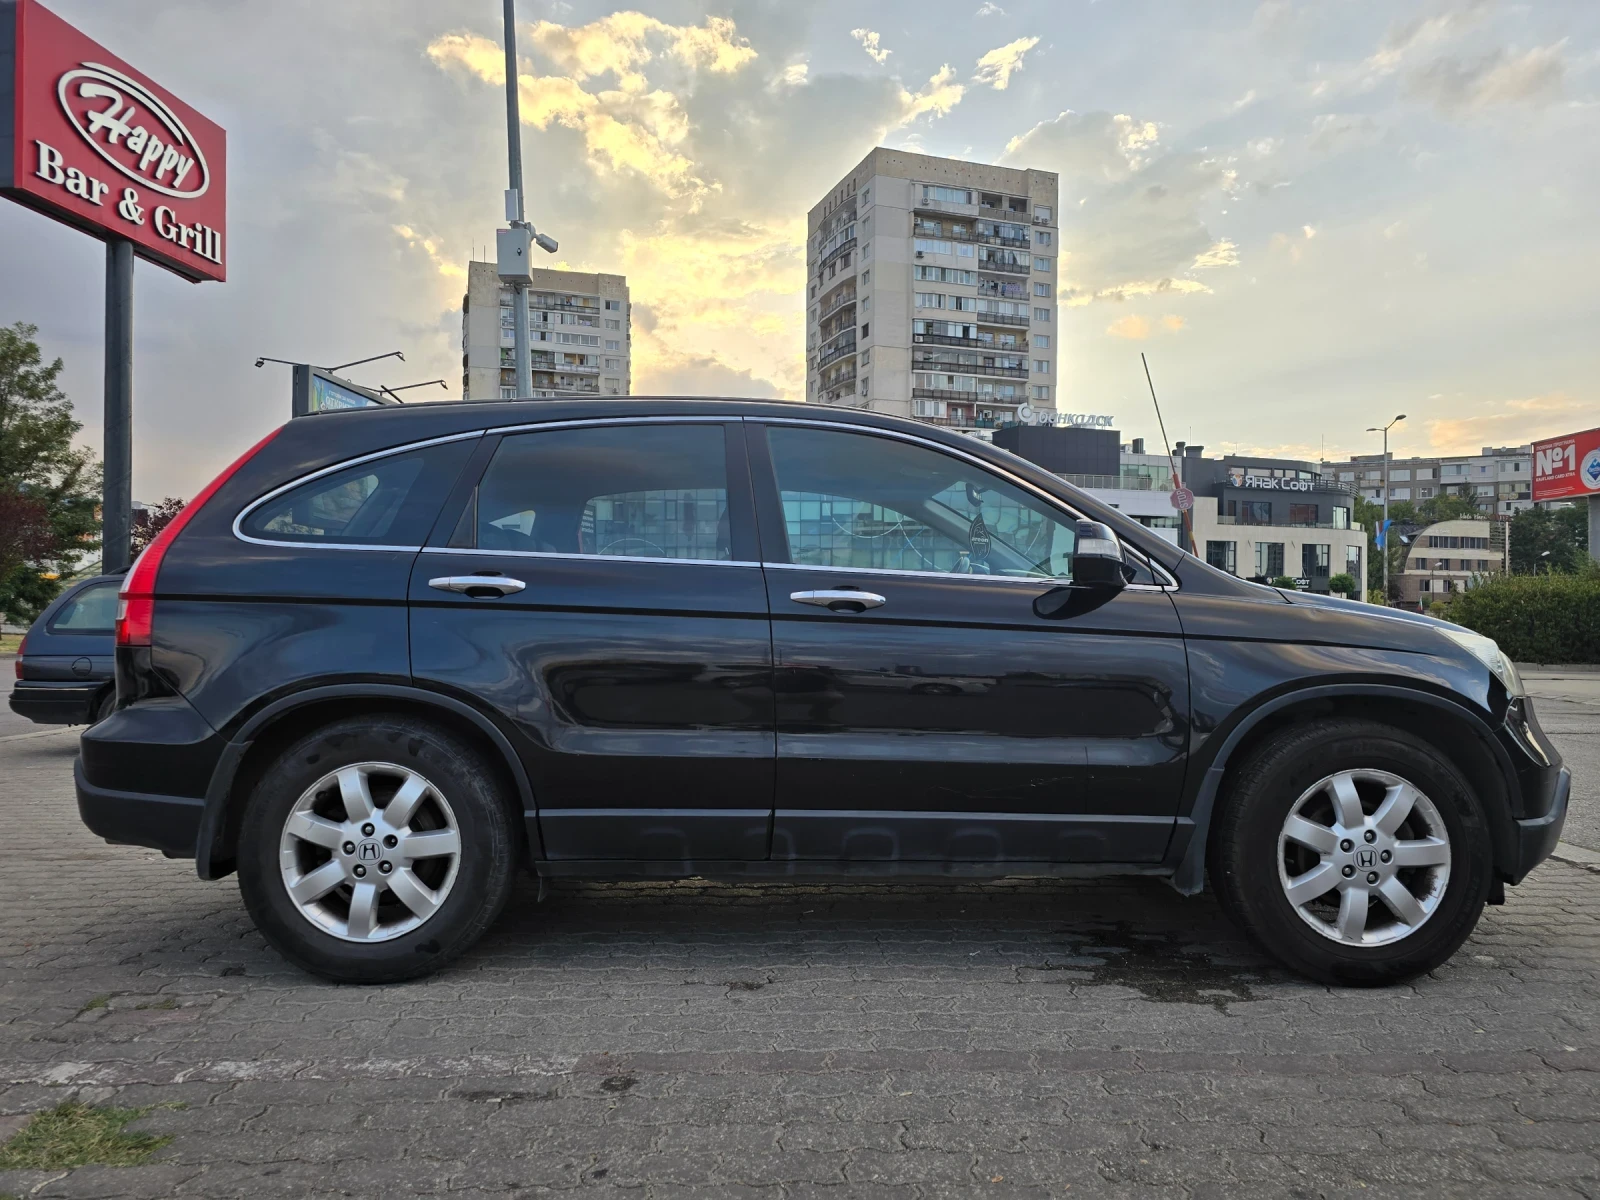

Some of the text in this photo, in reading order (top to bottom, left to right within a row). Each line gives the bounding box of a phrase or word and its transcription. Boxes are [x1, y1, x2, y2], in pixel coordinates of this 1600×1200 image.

[79, 82, 195, 188] Happy
[35, 139, 222, 265] Bar & Grill
[1176, 490, 1189, 509] STOP
[1245, 475, 1315, 492] Янак Софт
